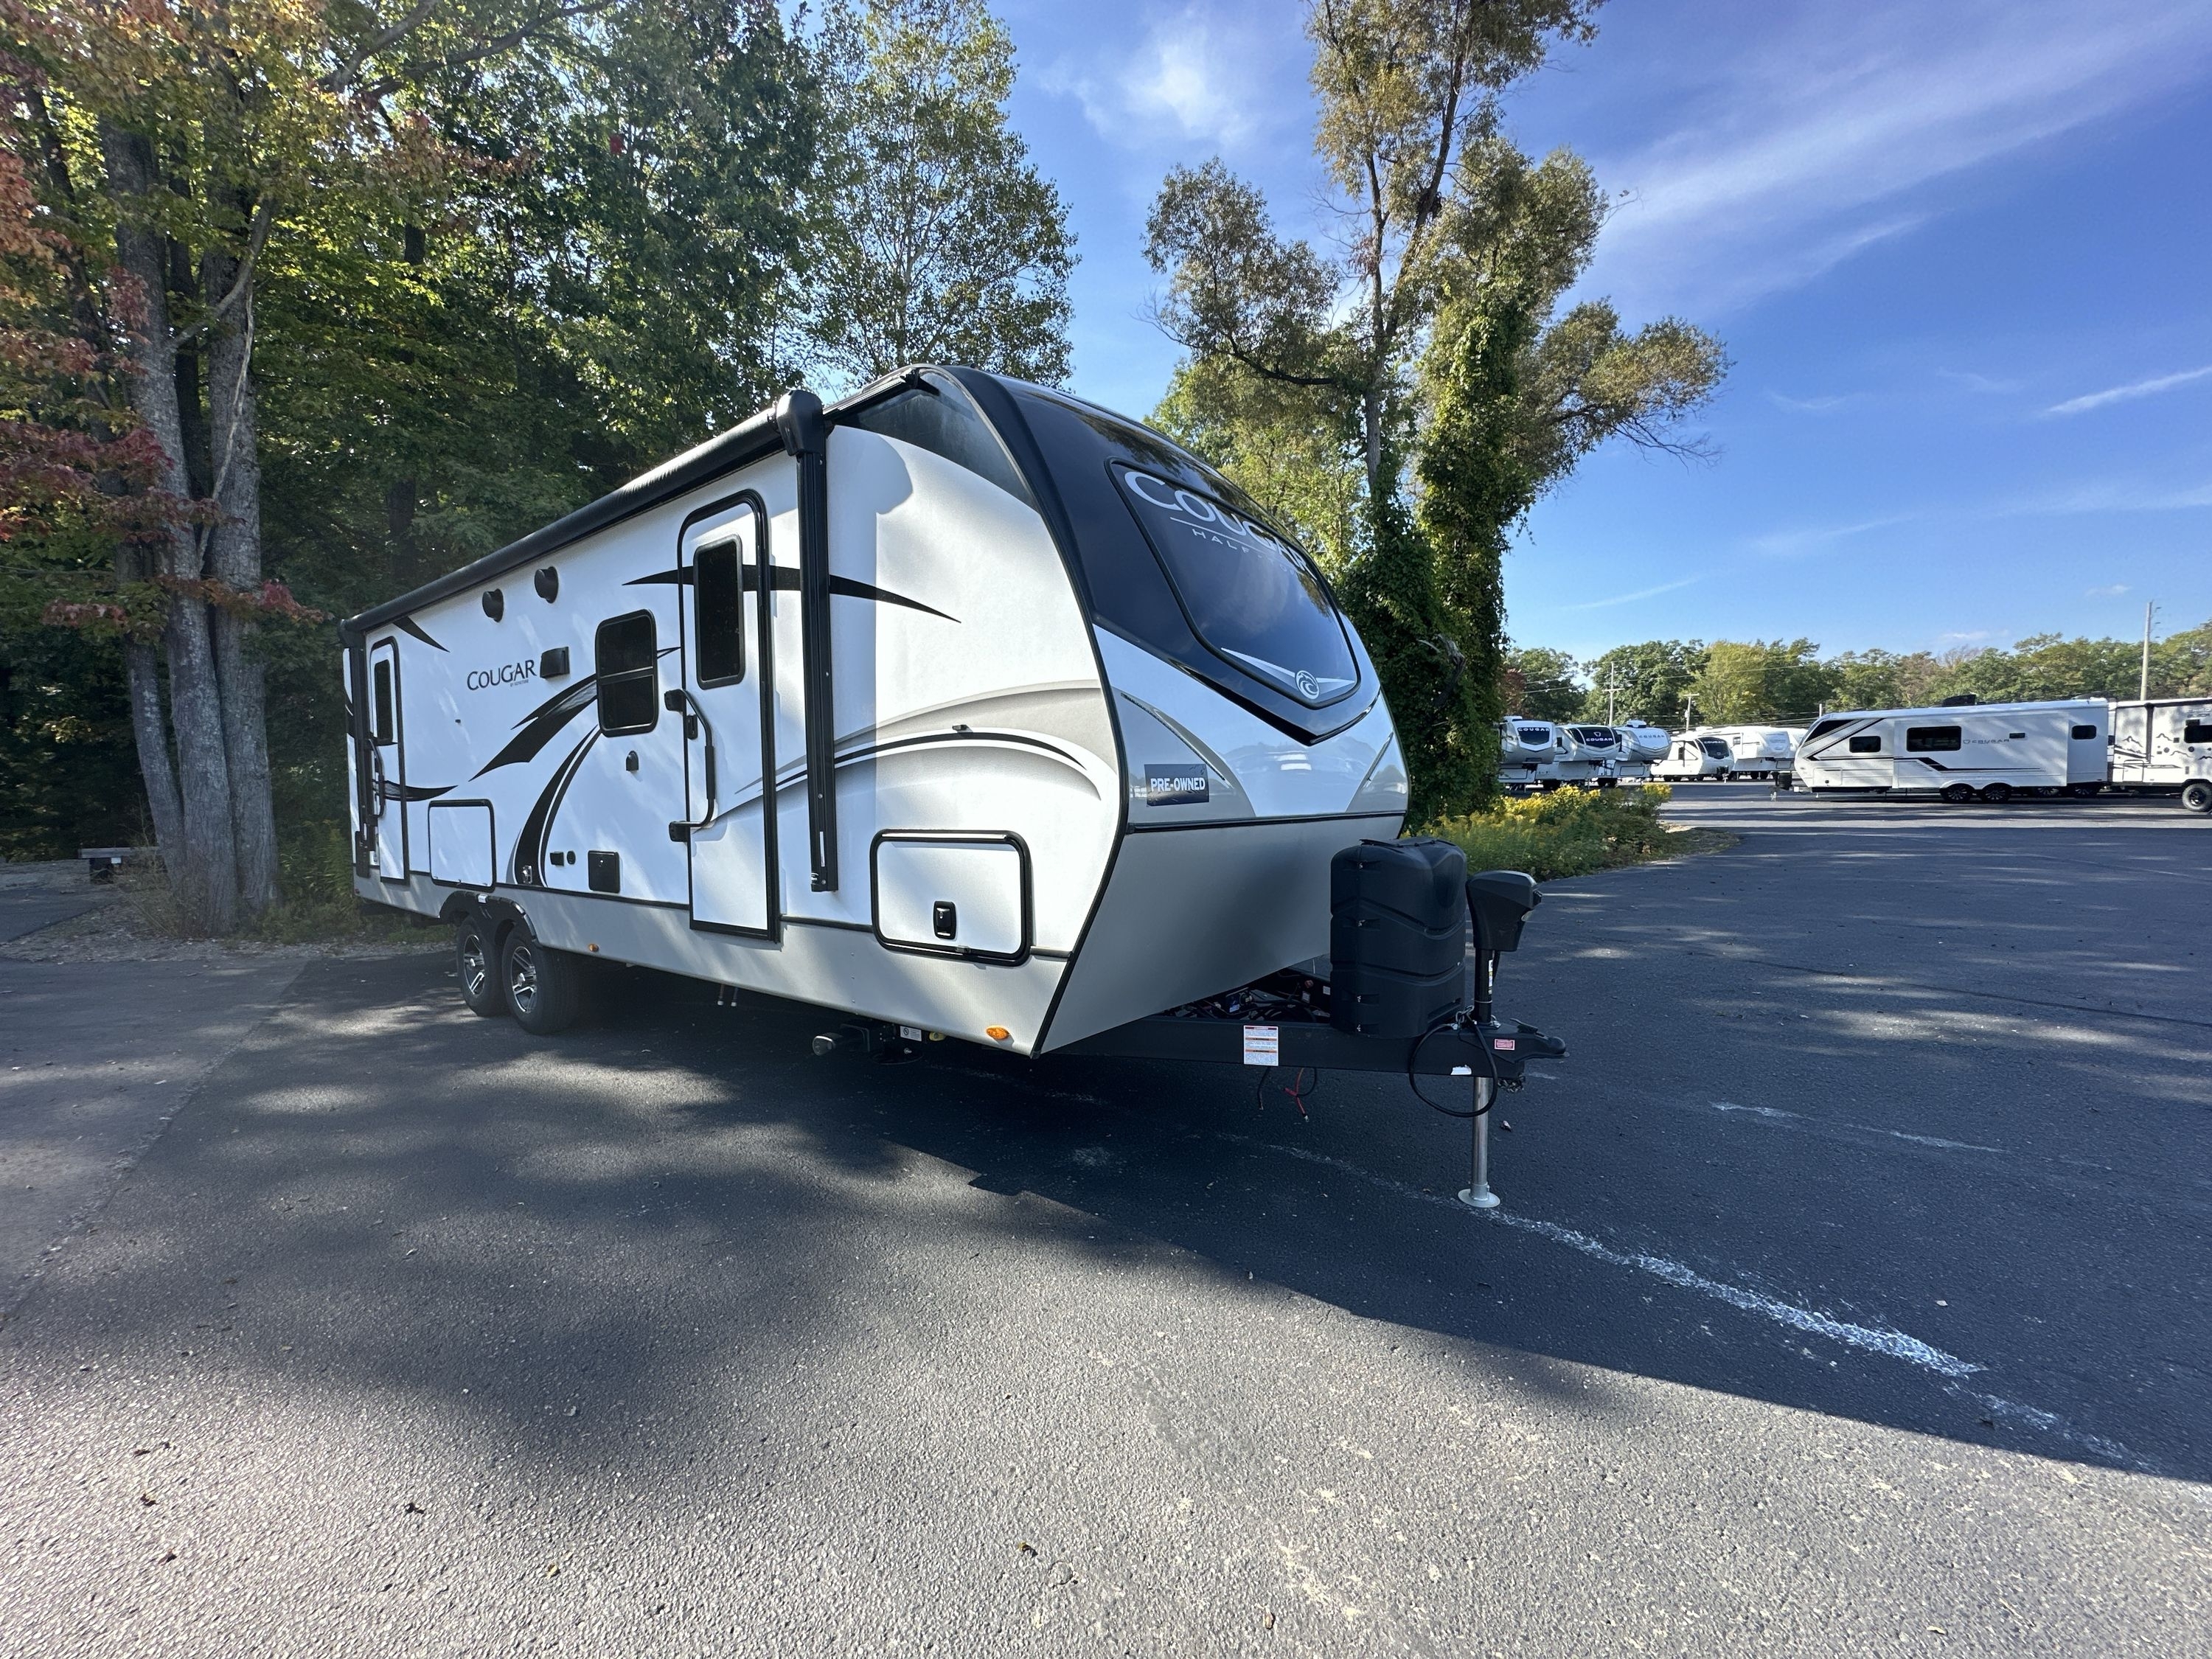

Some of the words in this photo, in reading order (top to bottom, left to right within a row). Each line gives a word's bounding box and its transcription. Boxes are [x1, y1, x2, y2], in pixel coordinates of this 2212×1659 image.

[1124, 471, 1318, 580] COUGAR
[467, 660, 537, 690] COUGAR
[1150, 777, 1206, 792] PRE-OWNED
